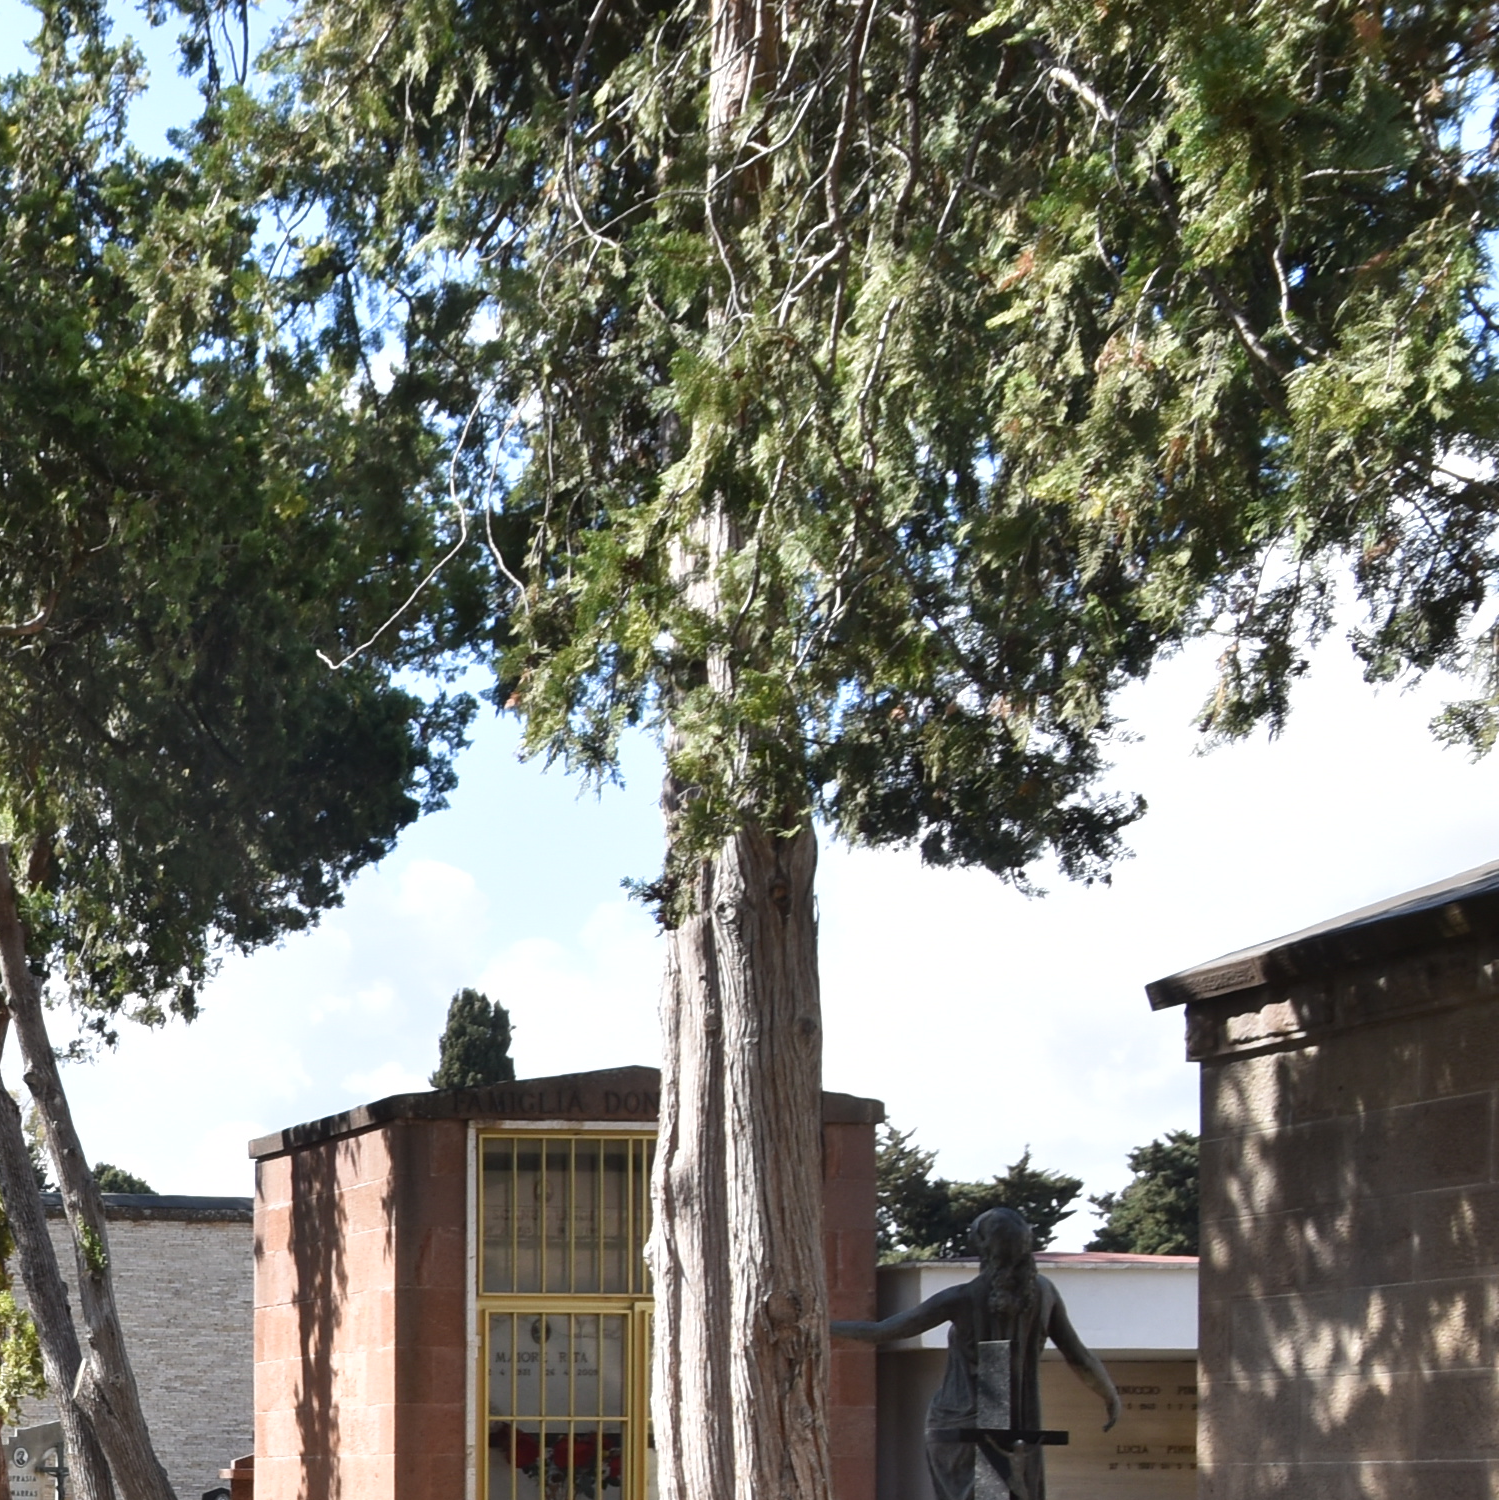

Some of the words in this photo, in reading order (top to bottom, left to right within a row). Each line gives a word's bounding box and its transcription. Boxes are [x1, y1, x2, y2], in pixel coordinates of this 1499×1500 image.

[453, 1087, 584, 1114] FAMIGLIA
[495, 1351, 548, 1363] MIOR
[559, 1351, 588, 1363] RTA
